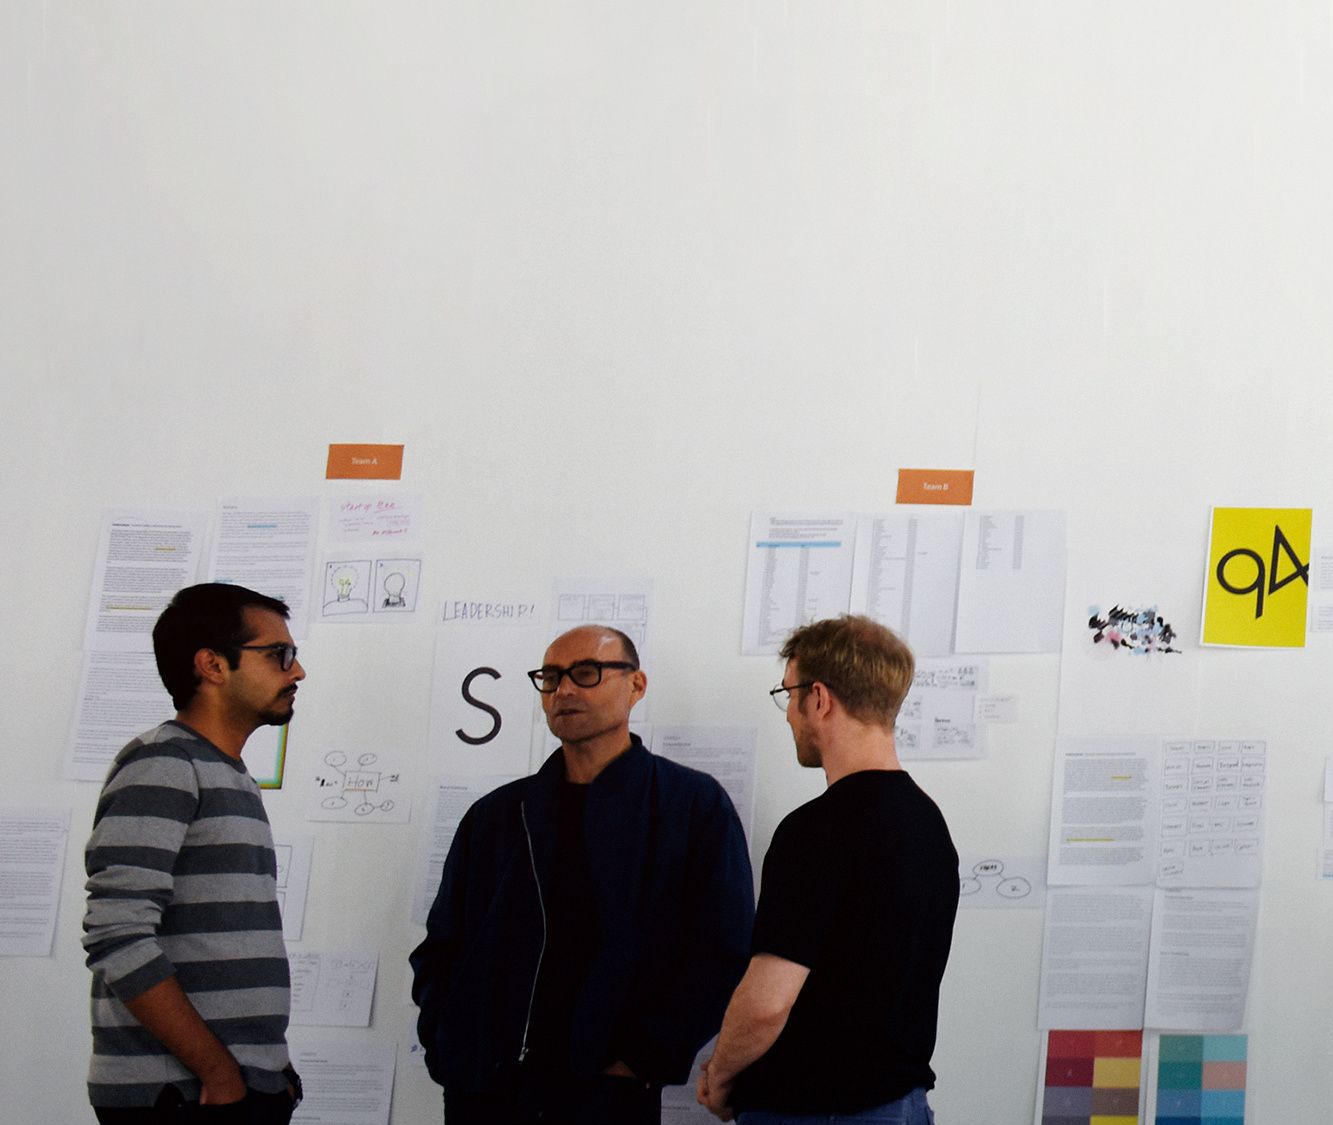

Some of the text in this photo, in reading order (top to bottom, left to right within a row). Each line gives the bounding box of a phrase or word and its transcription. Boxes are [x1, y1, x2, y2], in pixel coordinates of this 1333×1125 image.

[351, 457, 370, 465] Team
[923, 482, 942, 491] Team
[455, 666, 502, 745] S
